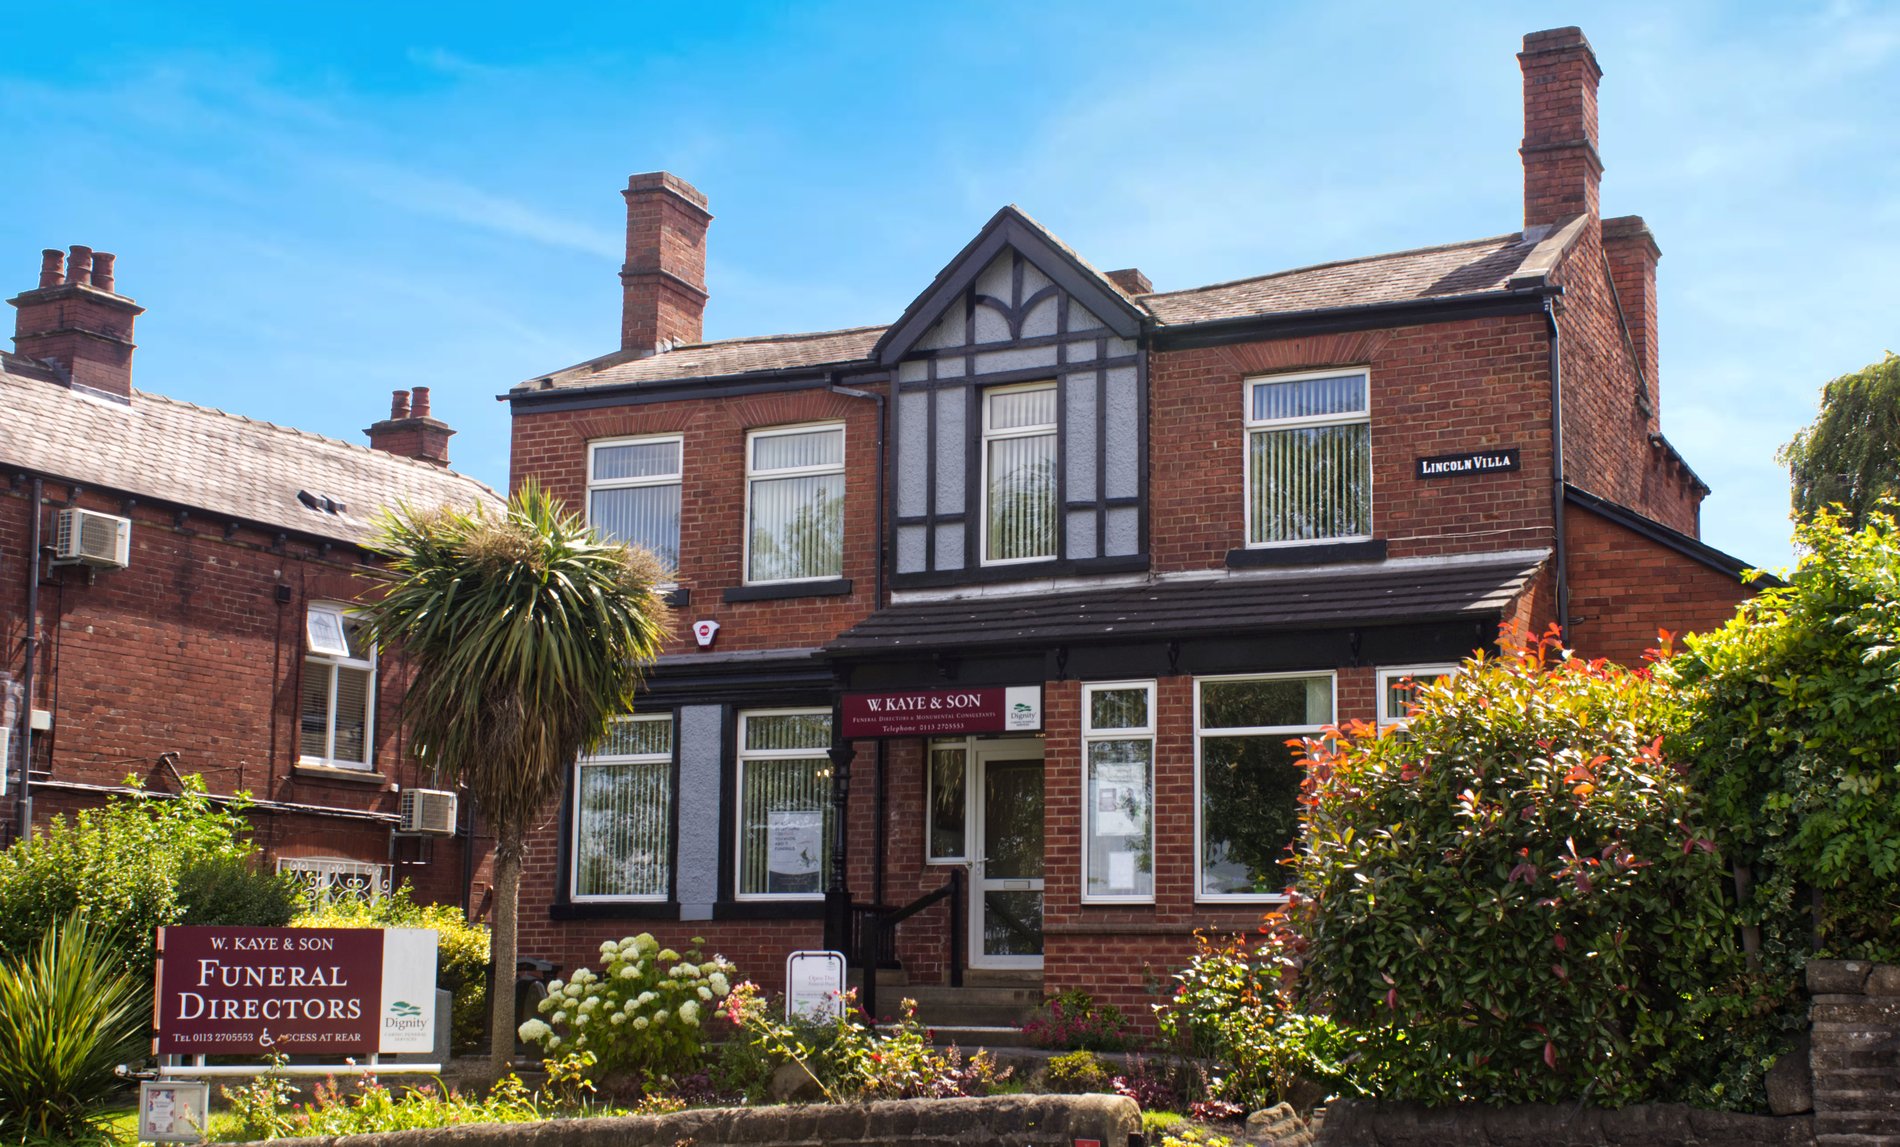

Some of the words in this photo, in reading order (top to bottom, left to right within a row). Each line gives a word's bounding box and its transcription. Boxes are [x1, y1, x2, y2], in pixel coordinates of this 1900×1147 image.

[1422, 460, 1472, 474] LINCOLN
[1473, 456, 1511, 469] VILLA
[867, 698, 882, 712] W.
[886, 697, 927, 711] KAYE
[930, 697, 943, 709] &
[946, 694, 981, 709] SON
[1010, 712, 1036, 720] Dignity
[882, 725, 916, 733] Telephone
[210, 937, 228, 950] W.
[234, 937, 279, 950] KAYE
[283, 937, 295, 951] &
[299, 937, 335, 951] SON
[196, 959, 348, 987] FUNERAL
[176, 992, 362, 1020] DIRECTORS
[385, 1017, 427, 1031] Dignity
[172, 1033, 191, 1042] TEL
[192, 1033, 213, 1042] 0113
[215, 1033, 254, 1042] 2705553
[318, 1032, 333, 1042] AT
[335, 1032, 361, 1042] REAR
